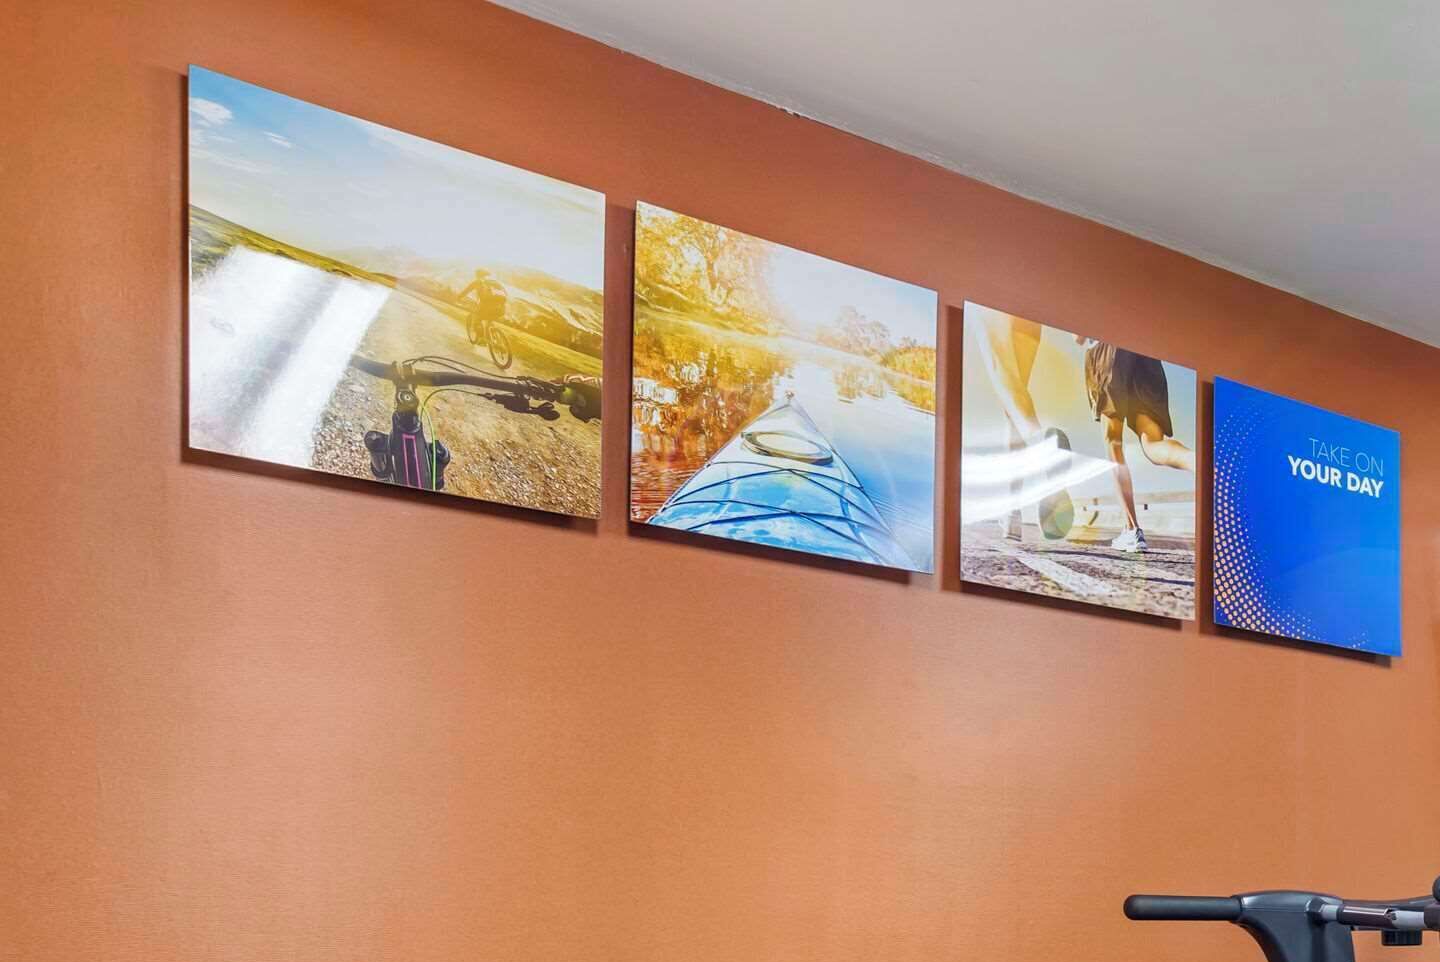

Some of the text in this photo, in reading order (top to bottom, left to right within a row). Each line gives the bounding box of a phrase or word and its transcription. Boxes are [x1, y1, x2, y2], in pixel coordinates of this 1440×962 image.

[1287, 455, 1384, 498] YOUR DAY
[1308, 437, 1384, 477] TAKE ON
